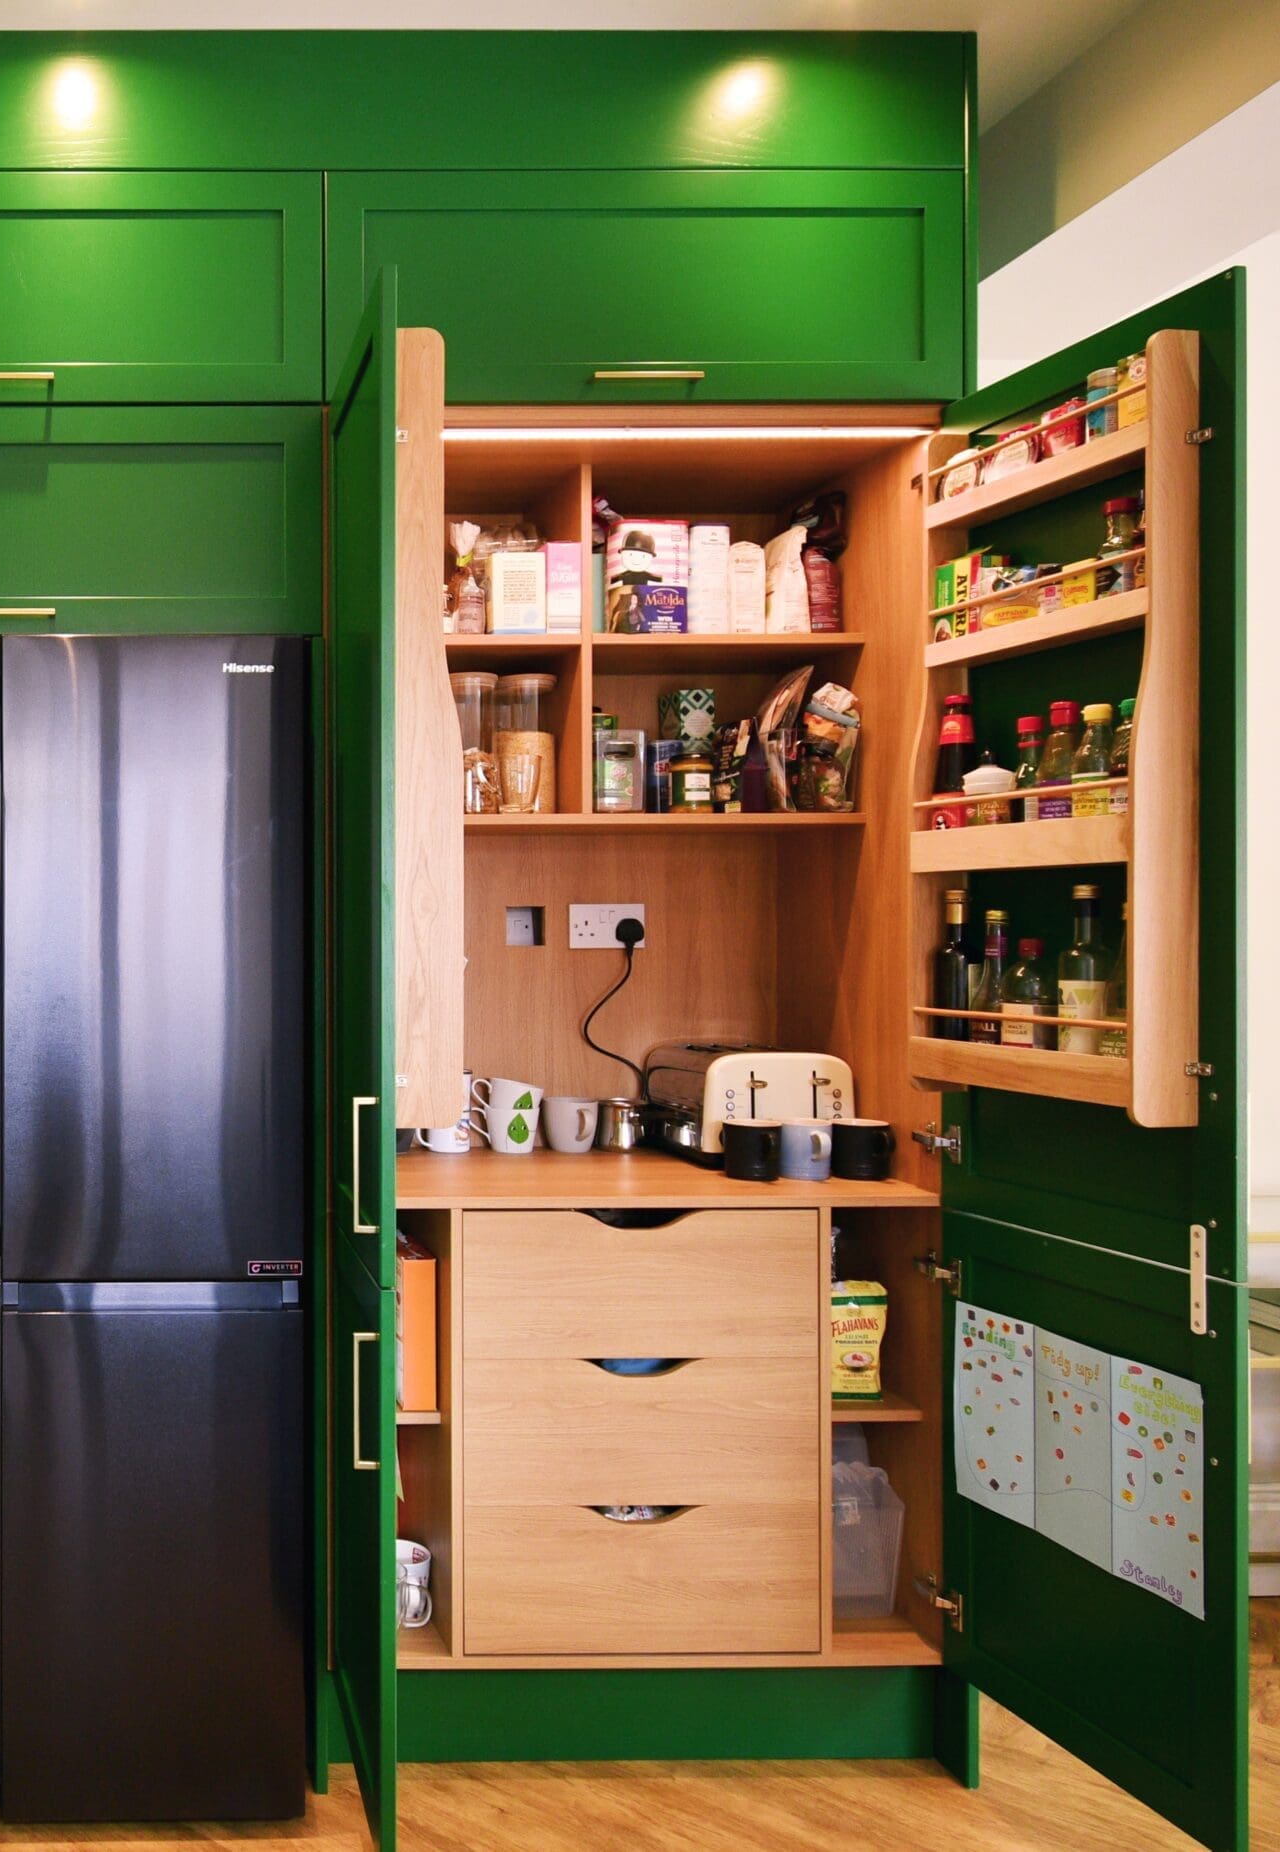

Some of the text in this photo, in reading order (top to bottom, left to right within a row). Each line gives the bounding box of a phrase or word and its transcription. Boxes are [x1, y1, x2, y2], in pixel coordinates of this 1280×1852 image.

[645, 594, 685, 607] Matilda
[222, 663, 274, 674] Hisense
[962, 1322, 1015, 1360] Reading
[1040, 1344, 1100, 1386] Tidy up!
[1119, 1559, 1184, 1606] Stanley
